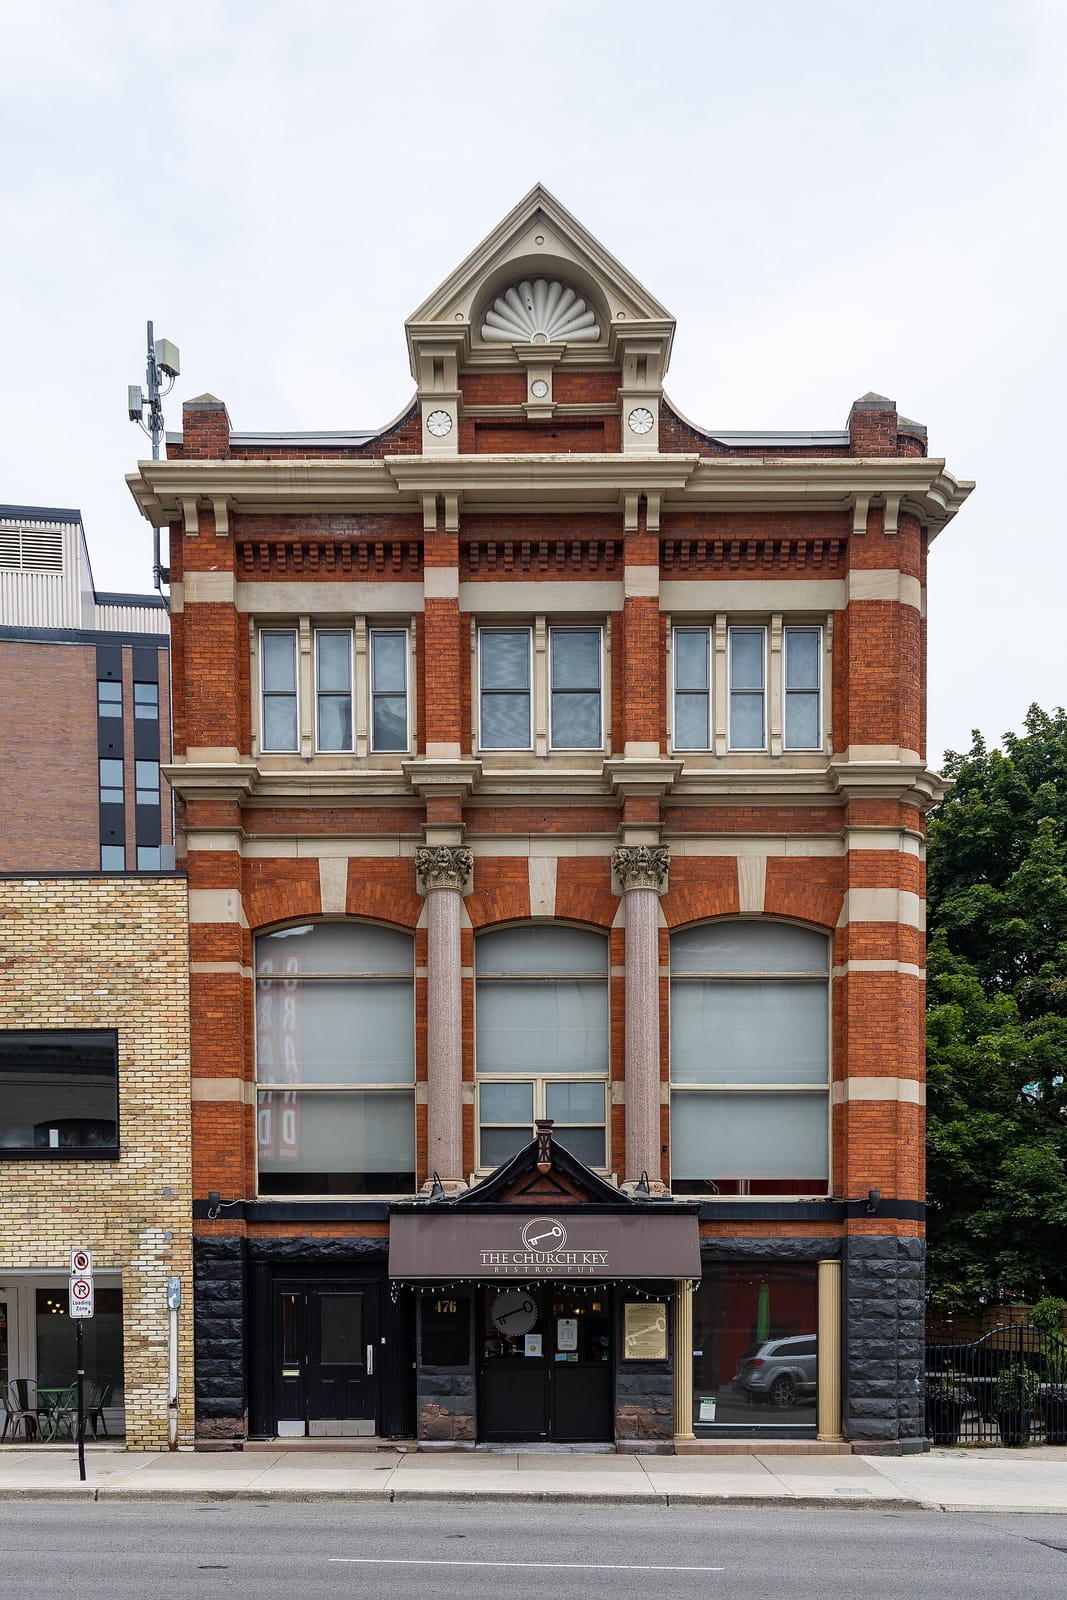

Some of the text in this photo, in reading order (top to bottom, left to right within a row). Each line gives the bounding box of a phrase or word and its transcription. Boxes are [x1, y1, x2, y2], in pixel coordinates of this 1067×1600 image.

[480, 1253, 608, 1264] THE CHURCH KEY
[434, 1300, 457, 1313] 476
